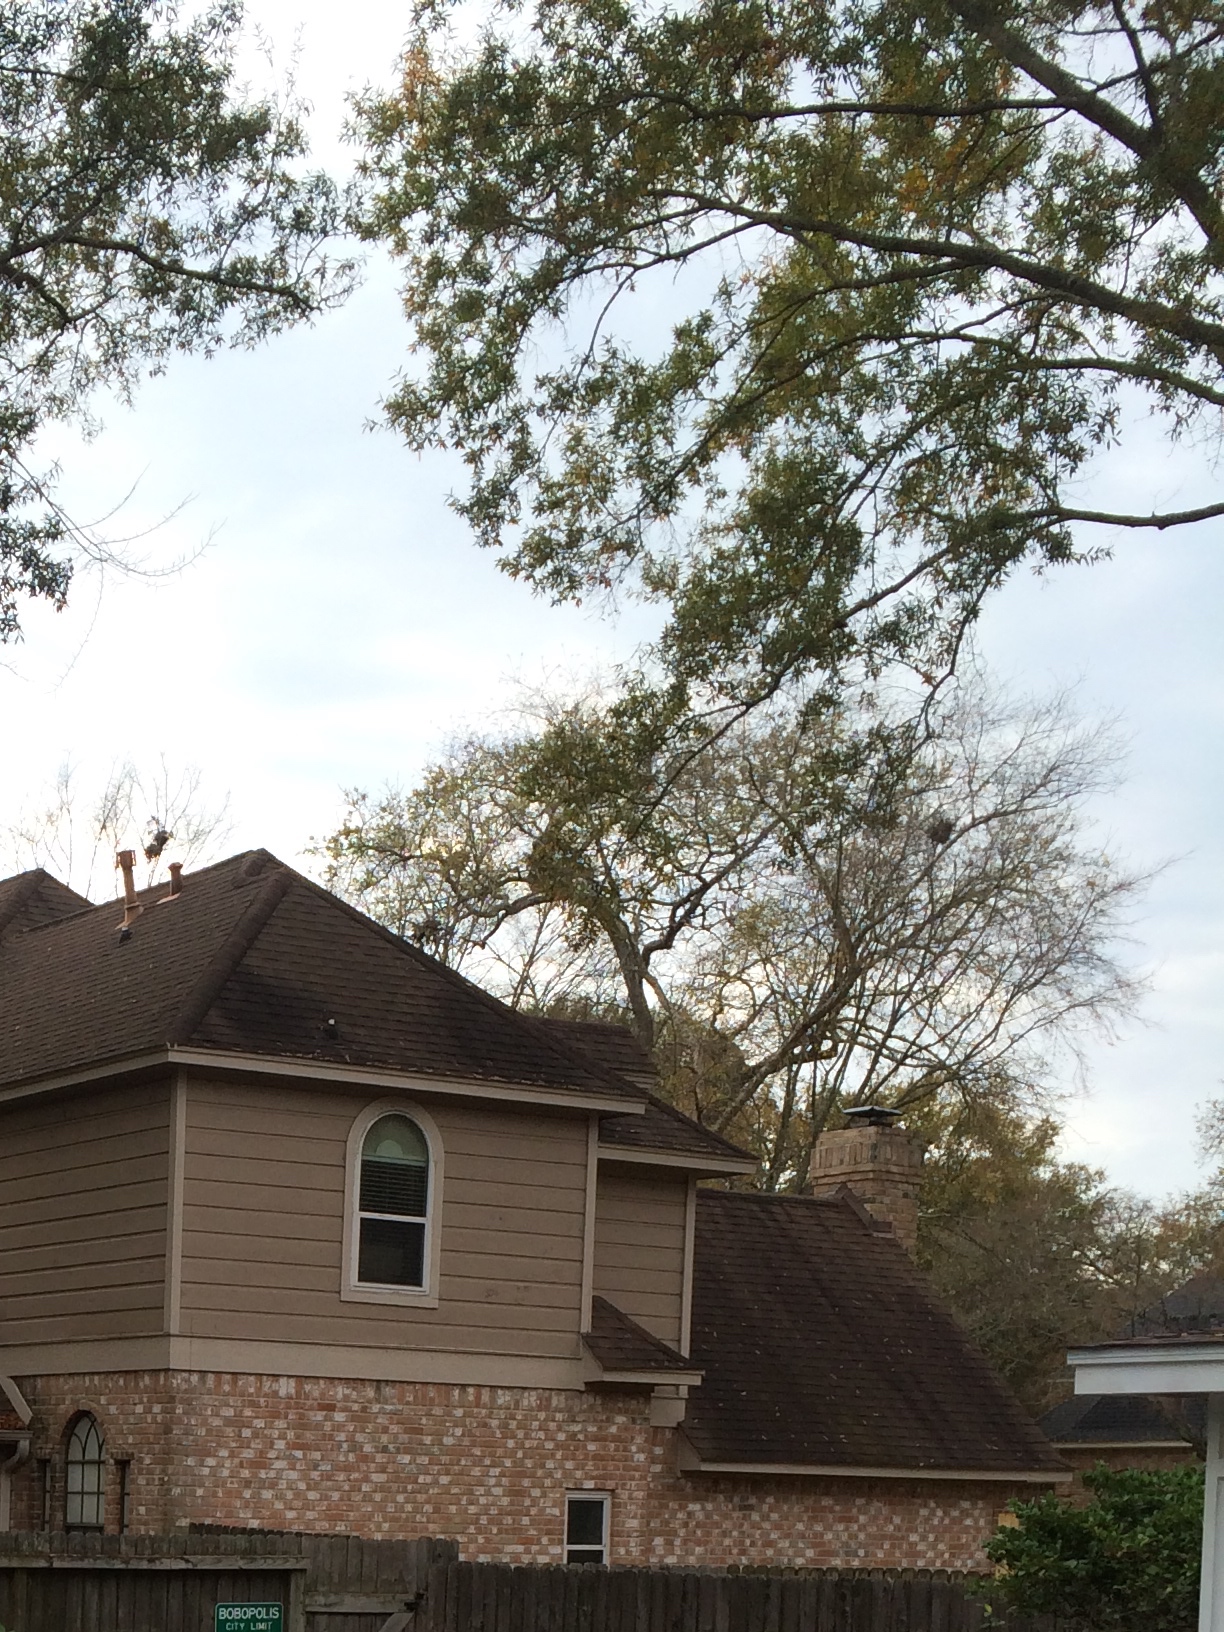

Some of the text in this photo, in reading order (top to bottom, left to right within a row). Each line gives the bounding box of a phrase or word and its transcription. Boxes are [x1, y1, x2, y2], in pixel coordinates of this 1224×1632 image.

[219, 1607, 279, 1619] BOBOPOLIS
[226, 1622, 272, 1630] CITY LIMIT
